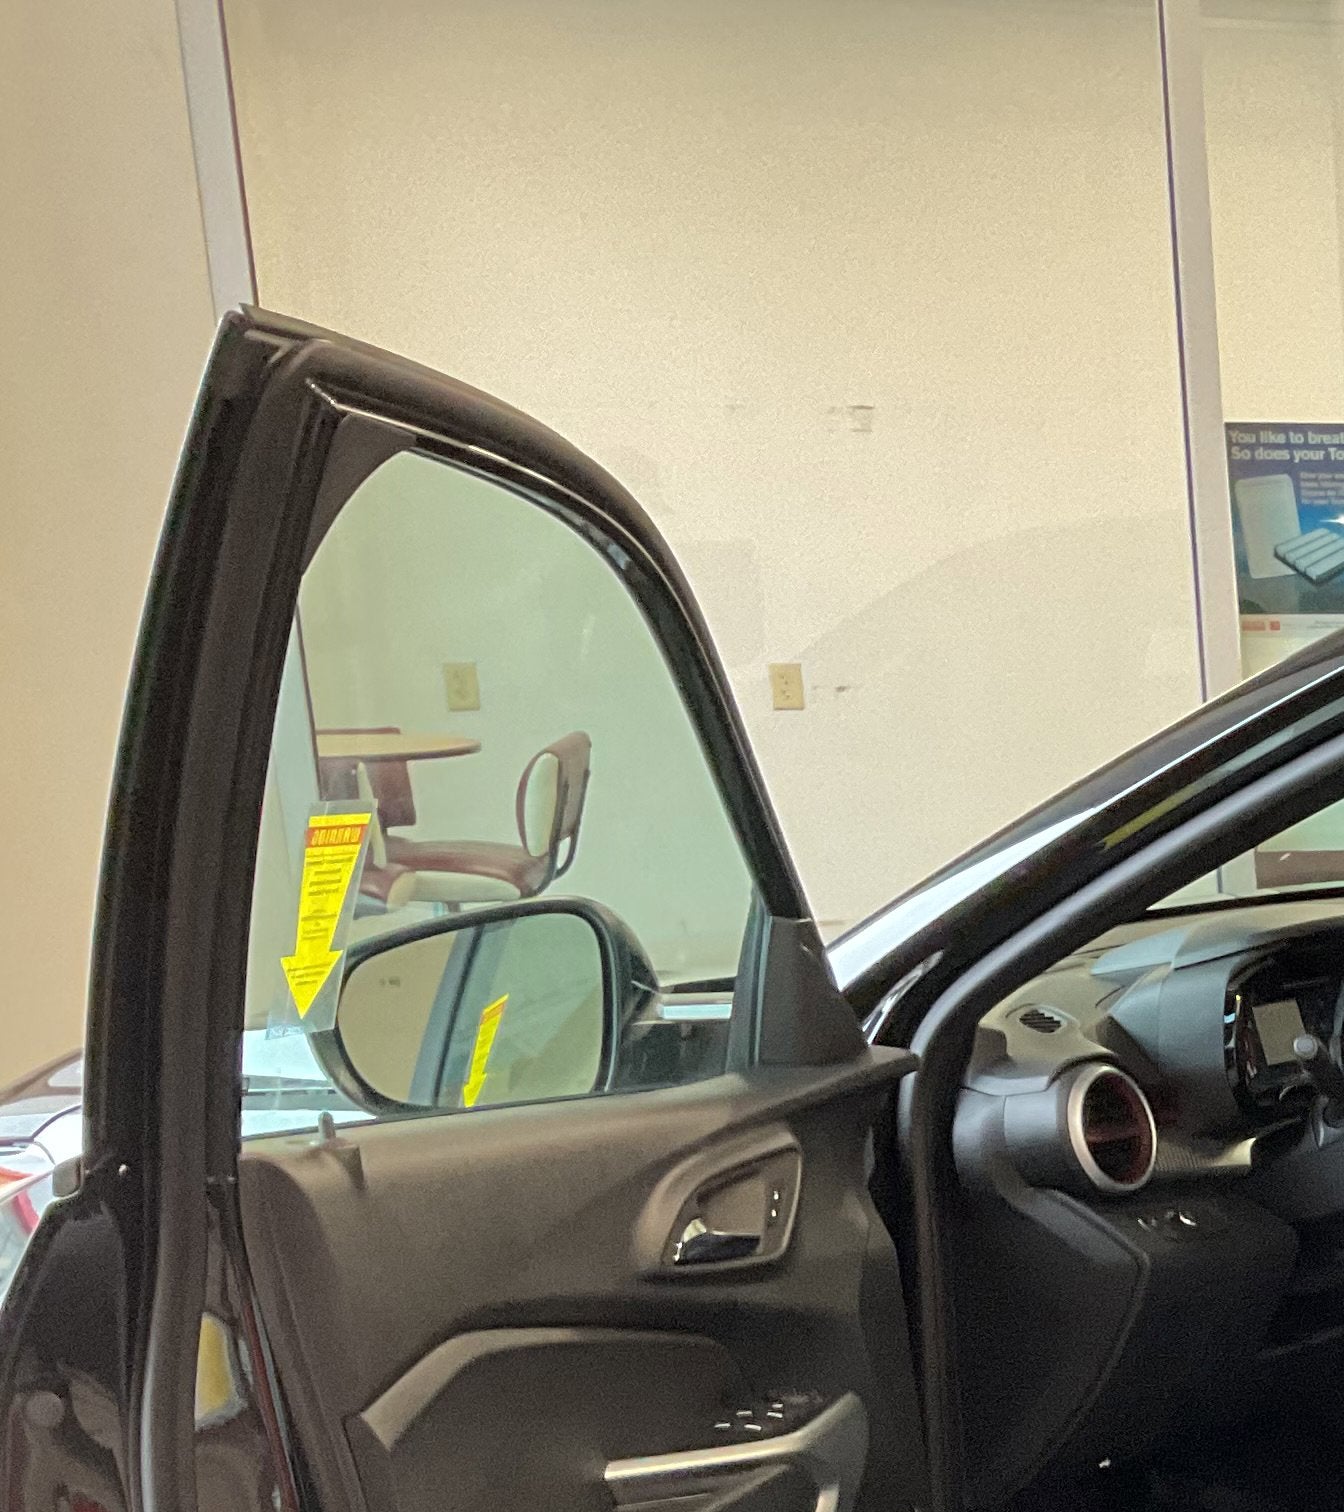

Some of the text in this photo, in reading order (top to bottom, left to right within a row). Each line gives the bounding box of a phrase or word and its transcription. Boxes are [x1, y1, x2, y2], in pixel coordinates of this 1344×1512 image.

[1229, 430, 1256, 444] You
[1260, 431, 1286, 444] like
[1289, 432, 1305, 444] to
[1230, 446, 1250, 460] So
[1255, 447, 1290, 460] does
[1293, 449, 1326, 463] your
